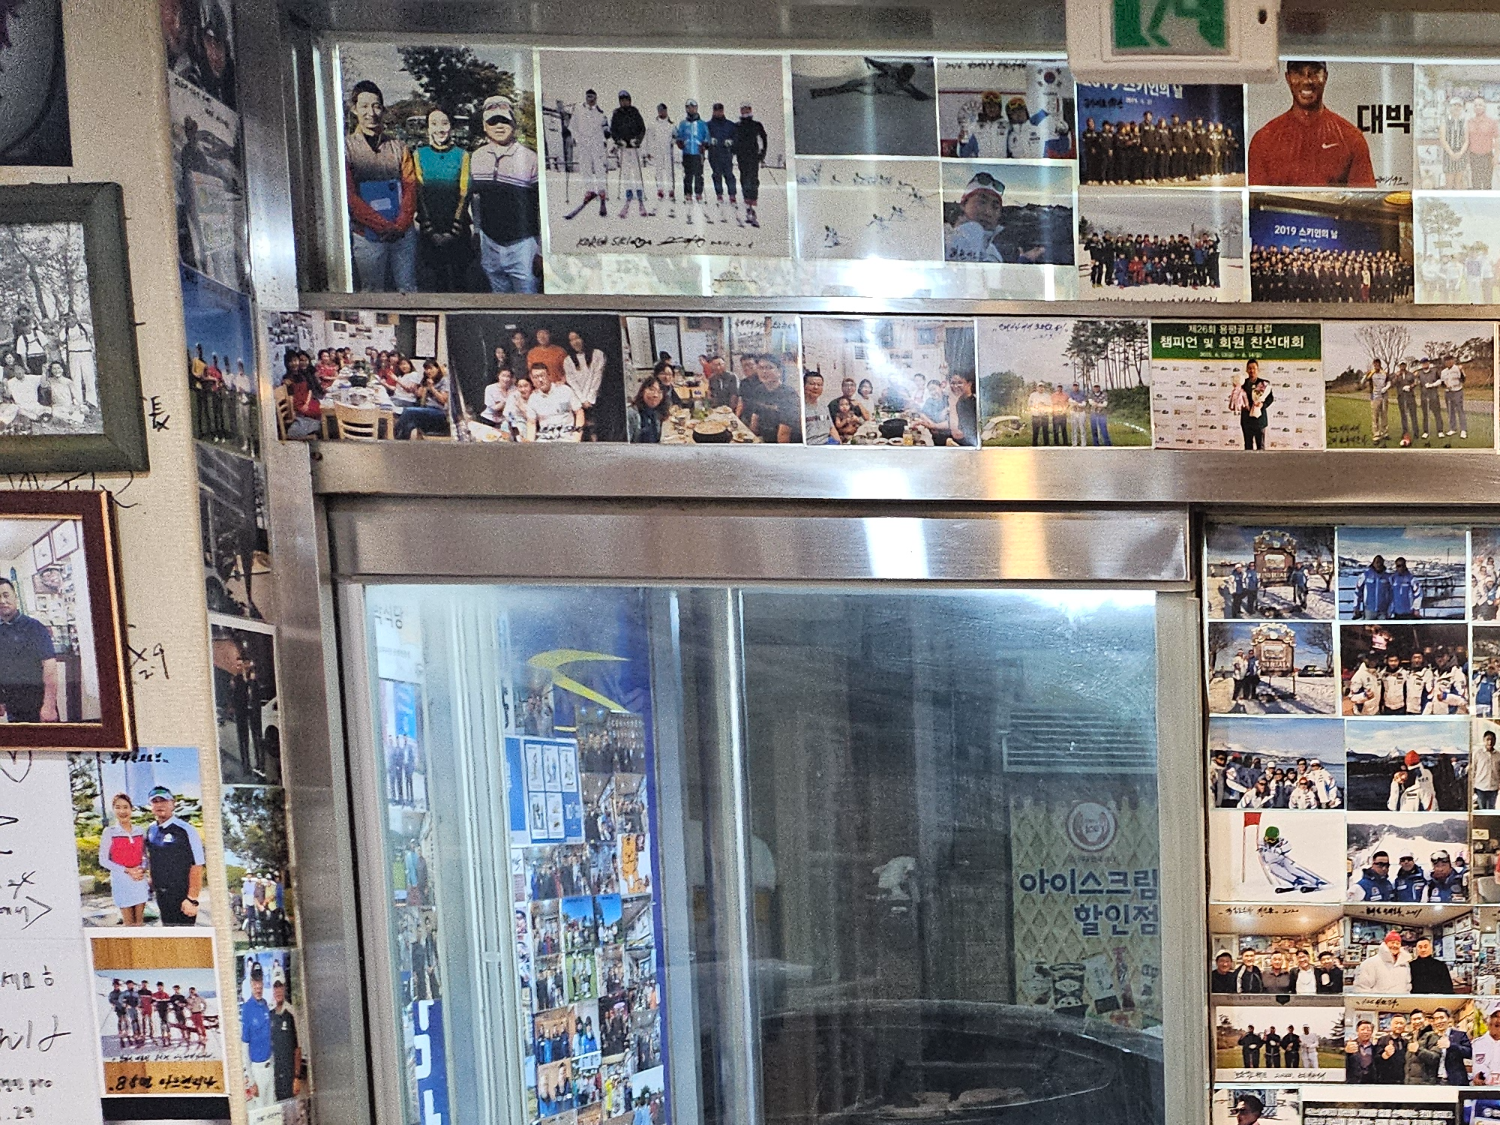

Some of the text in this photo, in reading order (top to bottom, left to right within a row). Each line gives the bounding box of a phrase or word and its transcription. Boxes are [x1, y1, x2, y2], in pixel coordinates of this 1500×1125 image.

[1357, 104, 1414, 134] 대박
[1274, 225, 1297, 236] 2019
[1299, 228, 1329, 239] 스키인의
[1160, 335, 1304, 349] 챔피언 및 회원 친선대회
[1018, 868, 1159, 901] 아이스크림
[1074, 903, 1160, 937] 할인점
